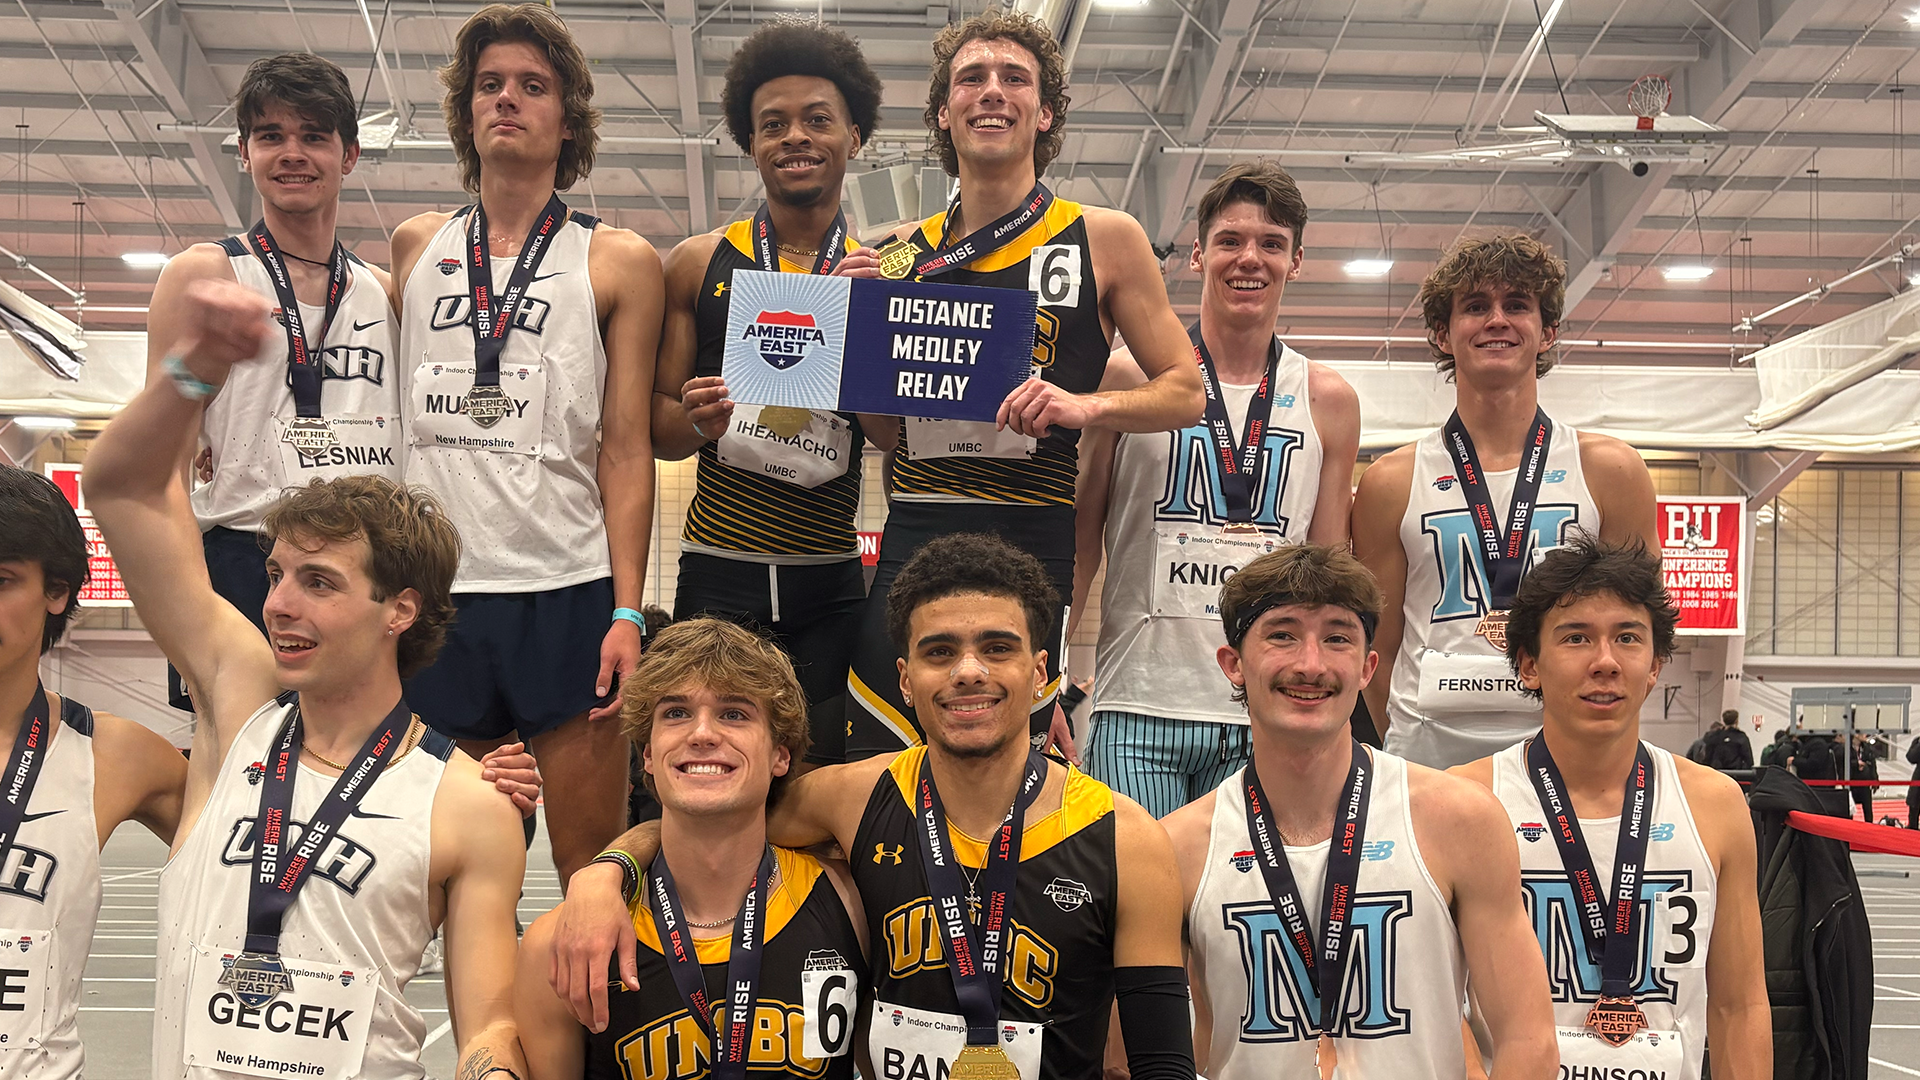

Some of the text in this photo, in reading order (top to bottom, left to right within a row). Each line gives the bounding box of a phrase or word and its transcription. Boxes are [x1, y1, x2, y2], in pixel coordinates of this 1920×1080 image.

[993, 194, 1045, 239] AMERICA EAST
[474, 246, 482, 268] EAST
[522, 214, 555, 270] AMERICA EAST
[760, 238, 772, 271] AMERICA
[820, 226, 842, 275] AMERICA EAS
[942, 242, 976, 264] RISE
[256, 234, 287, 288] AMERICA EAST
[882, 257, 909, 274] EAST
[1040, 247, 1071, 303] 6
[430, 295, 552, 335] UH
[502, 286, 522, 312] RISE
[888, 297, 994, 330] DISTANCE
[286, 306, 302, 338] RISE
[478, 310, 490, 338] RISE
[742, 324, 826, 346] AMERICA
[760, 340, 807, 354] EAST
[892, 334, 982, 364] MEDLEY
[286, 346, 384, 387] NH
[1198, 363, 1216, 400] AMERICA
[896, 372, 970, 401] RELAY
[1258, 377, 1268, 400] EAST
[462, 399, 510, 412] AMERICA
[473, 408, 500, 416] EAST
[283, 430, 337, 444] AMERICA
[296, 439, 324, 447] EAST
[436, 434, 515, 450] New Hampshire
[949, 443, 982, 452] UMBC
[1213, 420, 1230, 448] RISE
[299, 446, 394, 468] LESNIAK
[764, 462, 797, 479] UMBC
[1242, 445, 1258, 475] RISE
[1452, 431, 1478, 486] AMERICA EAST
[1525, 424, 1546, 484] AMERICA EAST
[1480, 504, 1494, 530] WHERE
[1512, 502, 1529, 530] RISE
[1665, 504, 1721, 548] BU
[1192, 536, 1213, 544] Indoor
[1215, 538, 1261, 548] Championship
[1483, 530, 1500, 560] RISE
[1506, 530, 1518, 558] WHERE
[92, 560, 110, 570] 2001
[1663, 559, 1727, 572] ONFERENCE
[1664, 572, 1733, 588] AMPIONS
[92, 580, 110, 590] 2011
[6, 717, 42, 806] AMERICA EAST
[276, 752, 290, 782] EAST
[339, 729, 394, 802] AMERICA EAST
[1341, 766, 1364, 856] AMERICA EAST
[1538, 766, 1576, 844] AMERICA EAST
[1629, 762, 1646, 839] AMERICA EAST
[270, 809, 282, 844] WHERE
[922, 779, 945, 866] AMERICA EAST
[1248, 785, 1278, 868] AMERICA EAST
[219, 814, 378, 898] UH
[298, 820, 330, 859] RISE
[998, 826, 1012, 860] EAST
[260, 844, 278, 884] RISE
[278, 855, 302, 891] WHERE
[1044, 886, 1092, 903] AMERICA
[1054, 894, 1082, 902] EAST
[1580, 868, 1598, 902] WHERE
[1619, 863, 1636, 900] RISE
[942, 896, 966, 938] RISE
[992, 892, 1006, 930] WHERE
[1279, 893, 1304, 934] RISE
[1335, 884, 1348, 922] WHERE
[1615, 900, 1626, 934] WHERE
[655, 876, 688, 964] AMERICA EAST
[742, 890, 756, 950] AMERICA
[1585, 902, 1607, 938] RISE
[1664, 895, 1698, 965] 3
[982, 930, 1000, 973] RISE
[1325, 920, 1342, 961] RISE
[806, 958, 846, 970] AMERICA
[952, 938, 970, 977] WHERE
[226, 969, 290, 990] AMERICA
[237, 982, 276, 994] EAST
[208, 992, 354, 1042] GECEK
[733, 980, 751, 1022] RISE
[818, 975, 848, 1054] 6
[907, 1017, 932, 1028] Indoor
[934, 1022, 967, 1034] Champi
[1559, 1030, 1585, 1038] Indoor
[1590, 1013, 1646, 1026] AMERICA
[1602, 1022, 1633, 1032] EAST
[729, 1022, 740, 1062] WHERE
[216, 1050, 325, 1076] New Hampshire
[954, 1063, 1017, 1076] AMERICA
